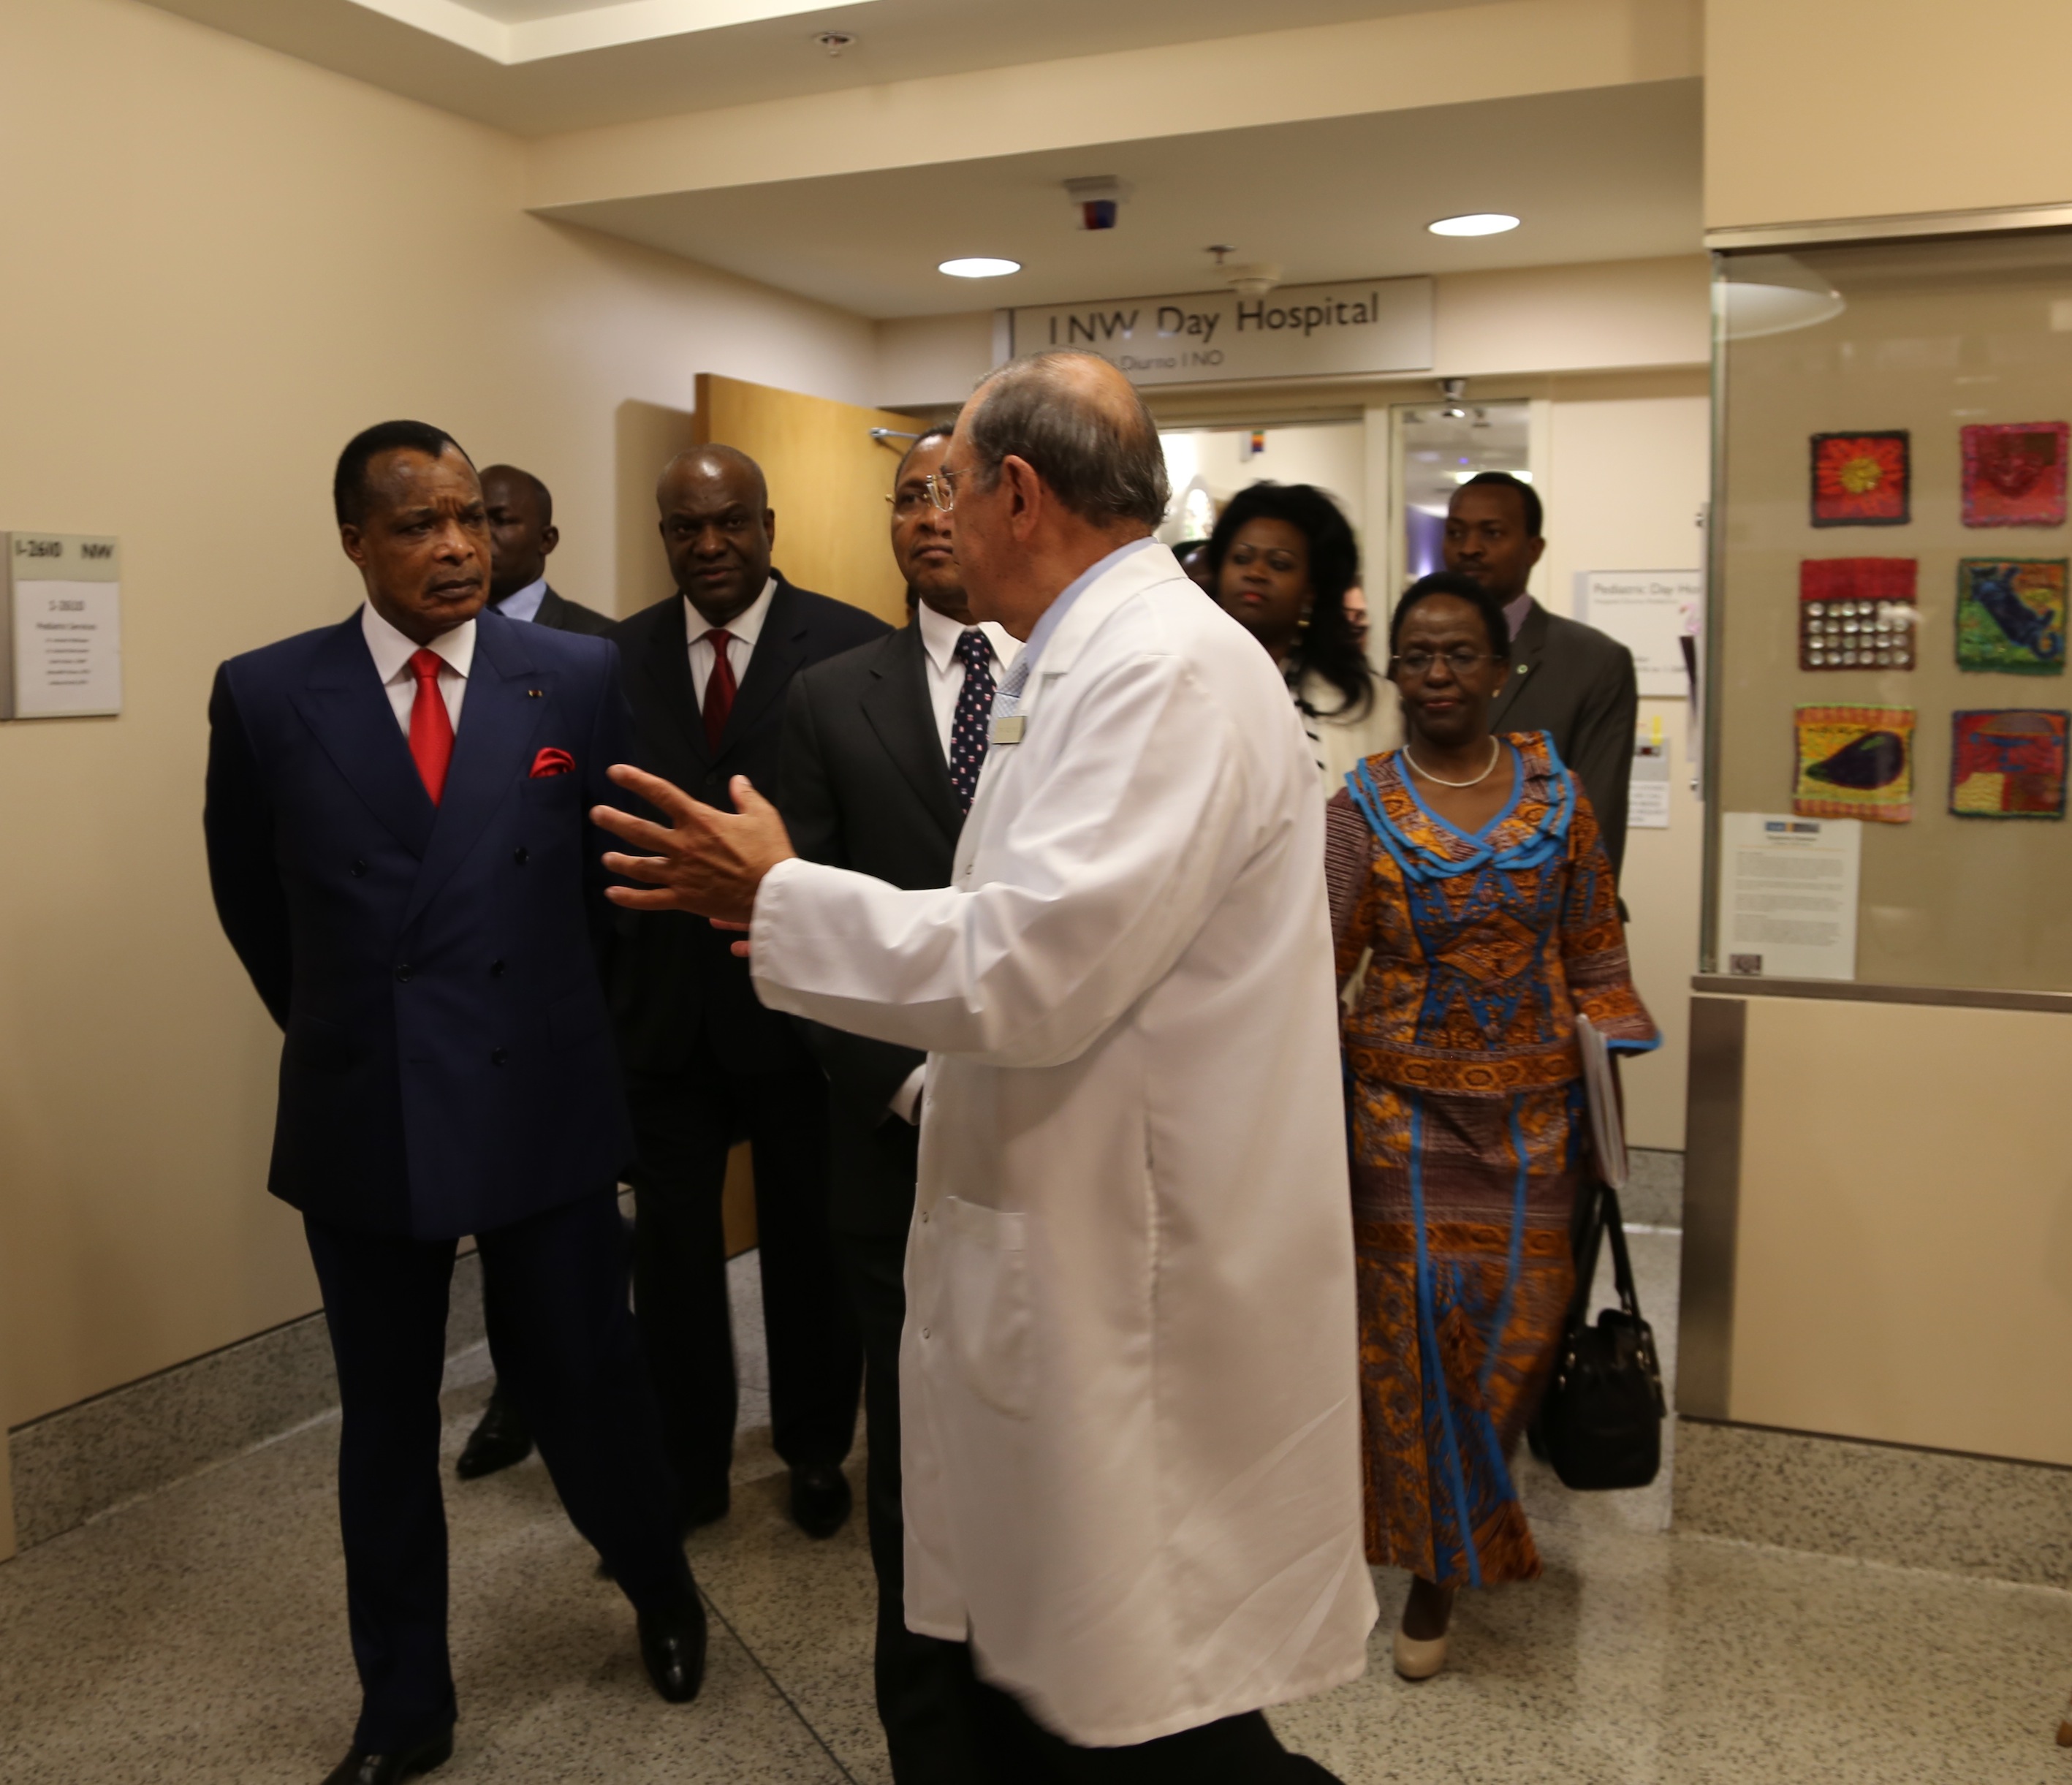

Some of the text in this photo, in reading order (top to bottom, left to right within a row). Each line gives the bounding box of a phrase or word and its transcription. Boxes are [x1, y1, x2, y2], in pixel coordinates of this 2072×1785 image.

[1158, 306, 1221, 343] Day
[1237, 292, 1378, 337] Hospital
[80, 543, 115, 560] NW
[1650, 582, 1674, 596] Day
